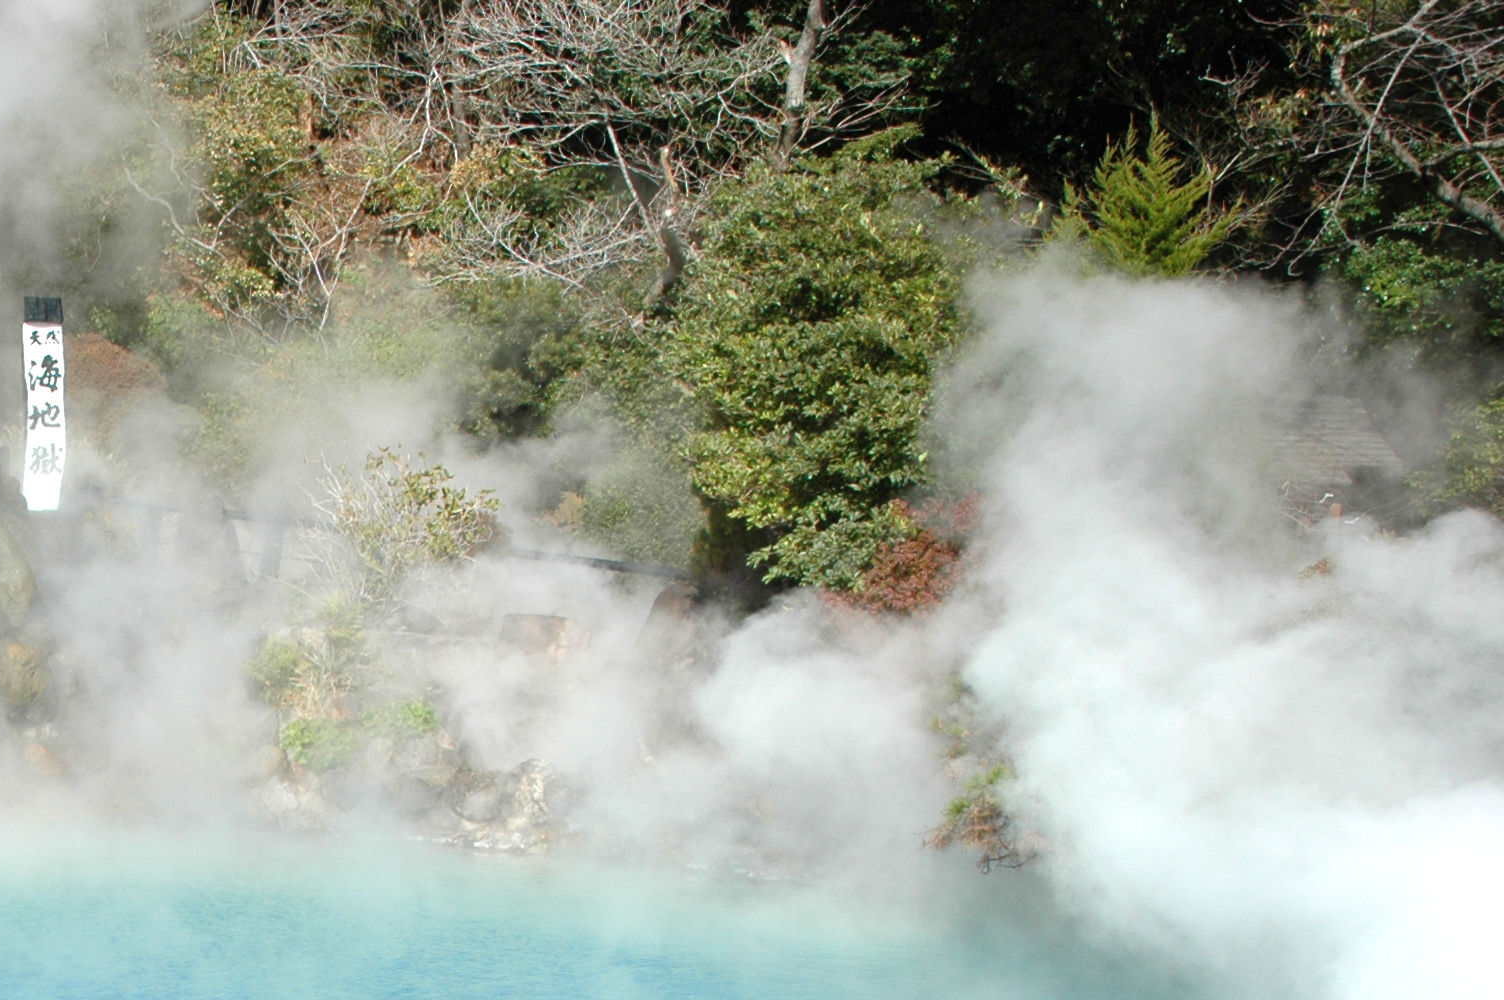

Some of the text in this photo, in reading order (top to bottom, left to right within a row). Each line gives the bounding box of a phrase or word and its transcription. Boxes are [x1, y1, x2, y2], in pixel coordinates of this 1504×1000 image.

[30, 330, 60, 346] 天然
[28, 354, 62, 475] 海地獄
